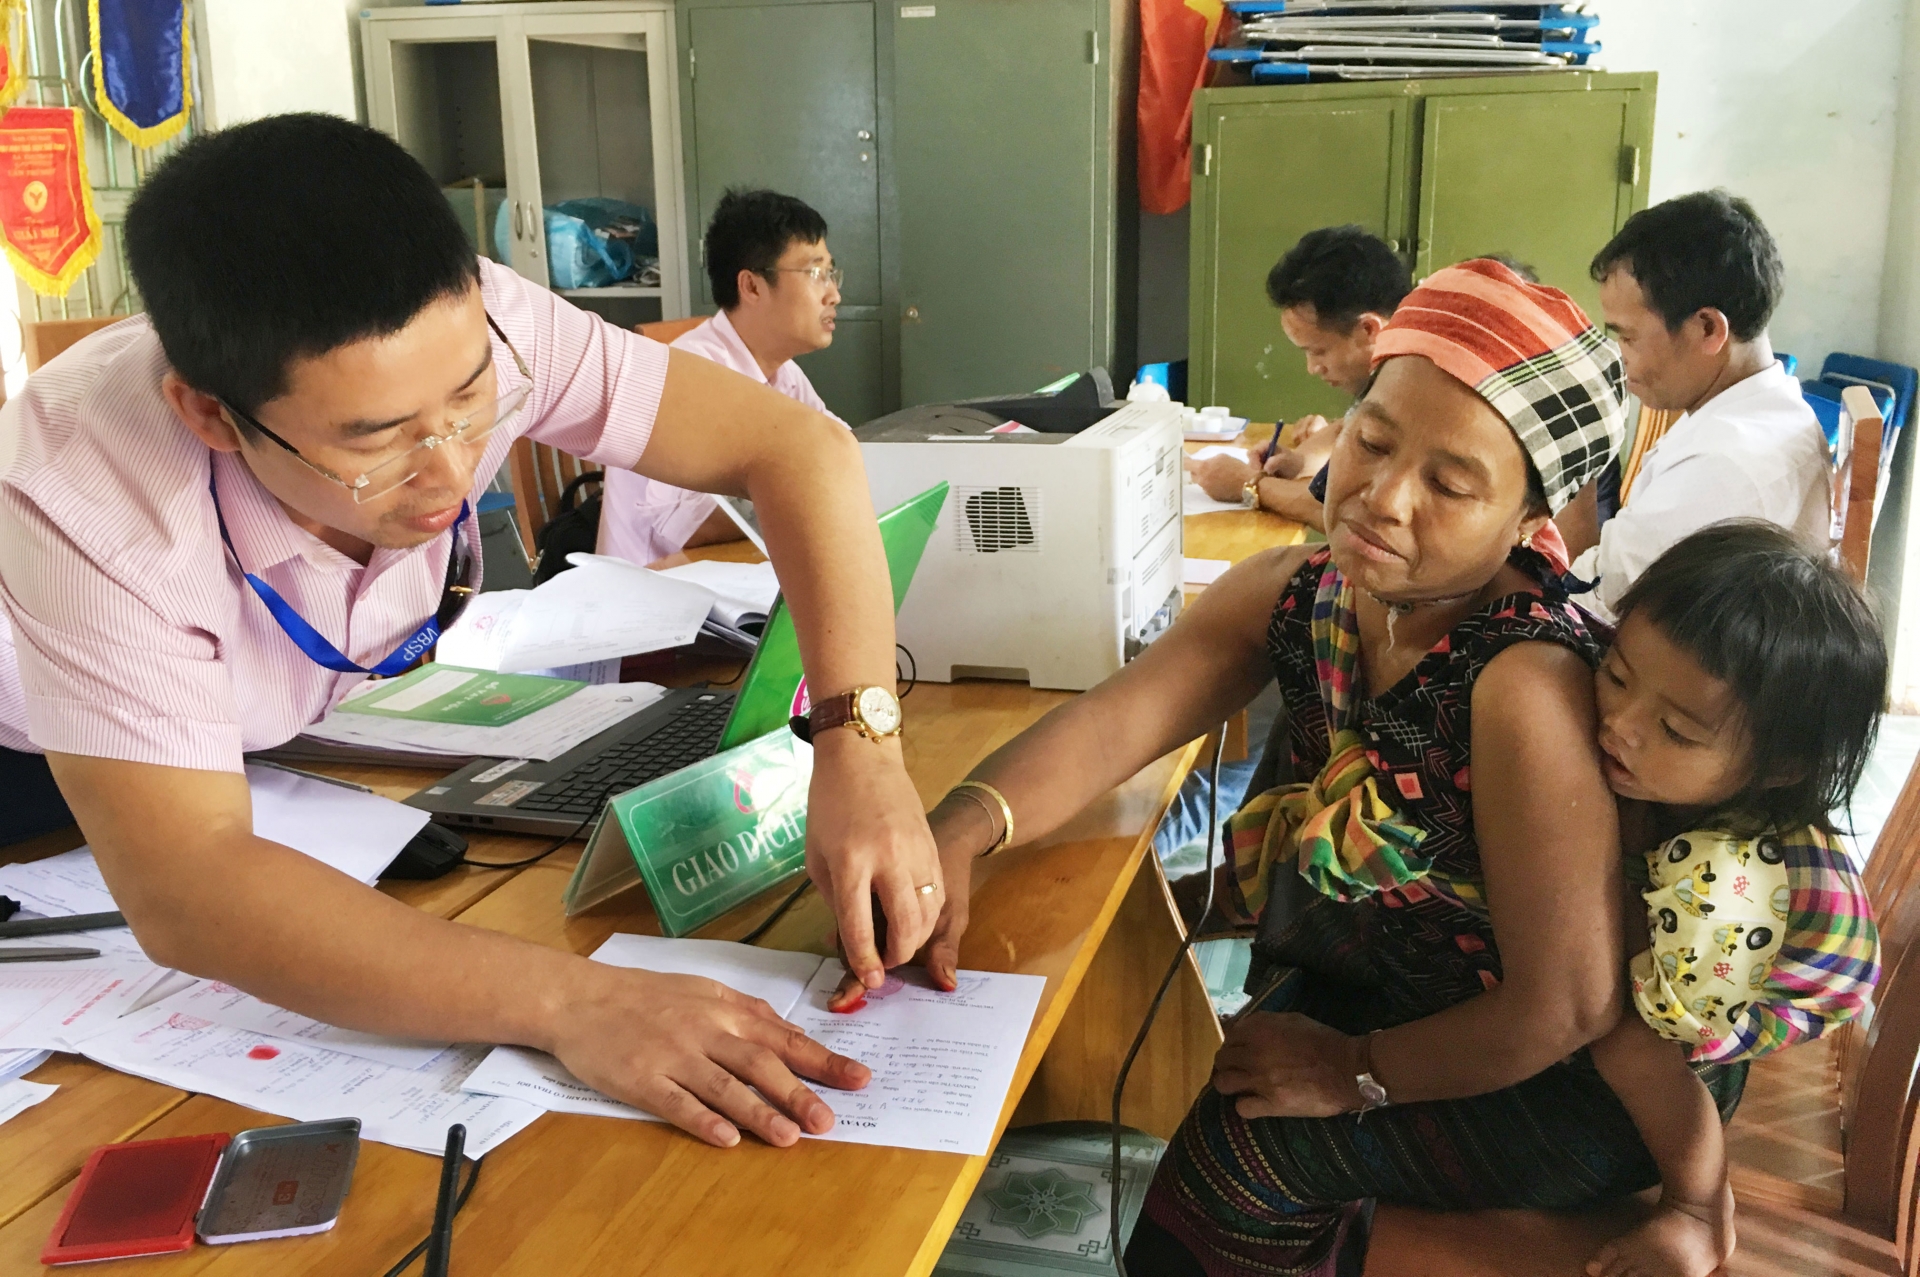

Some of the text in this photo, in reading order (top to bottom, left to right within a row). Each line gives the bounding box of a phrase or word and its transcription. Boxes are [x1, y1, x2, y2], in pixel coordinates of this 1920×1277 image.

[403, 627, 438, 661] VBSP
[673, 812, 804, 895] GIAO DỊCH
